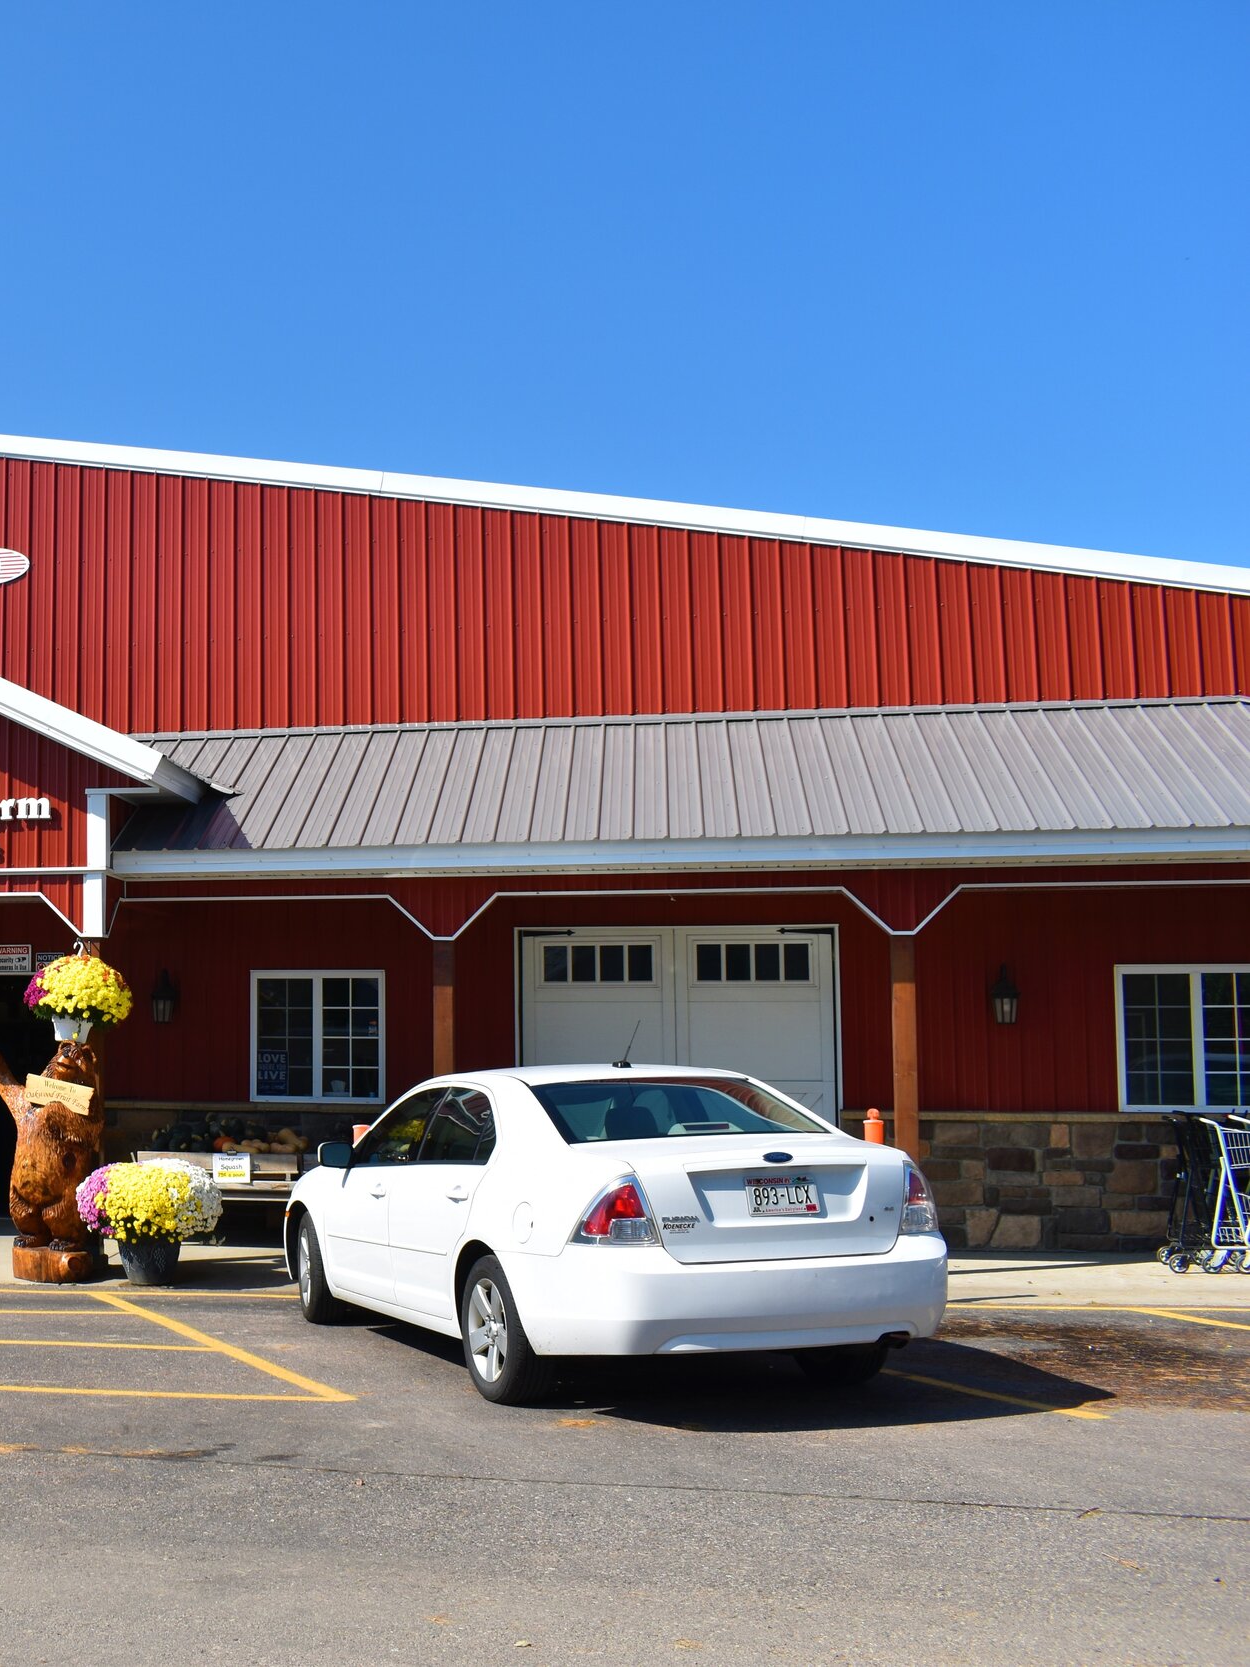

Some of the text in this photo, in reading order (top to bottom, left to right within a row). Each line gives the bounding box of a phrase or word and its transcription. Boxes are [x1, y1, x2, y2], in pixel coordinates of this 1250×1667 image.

[258, 1053, 287, 1063] LOVE
[258, 1071, 287, 1080] LIVE
[746, 1176, 784, 1184] WISCONSIN
[753, 1185, 813, 1206] 893-LCX
